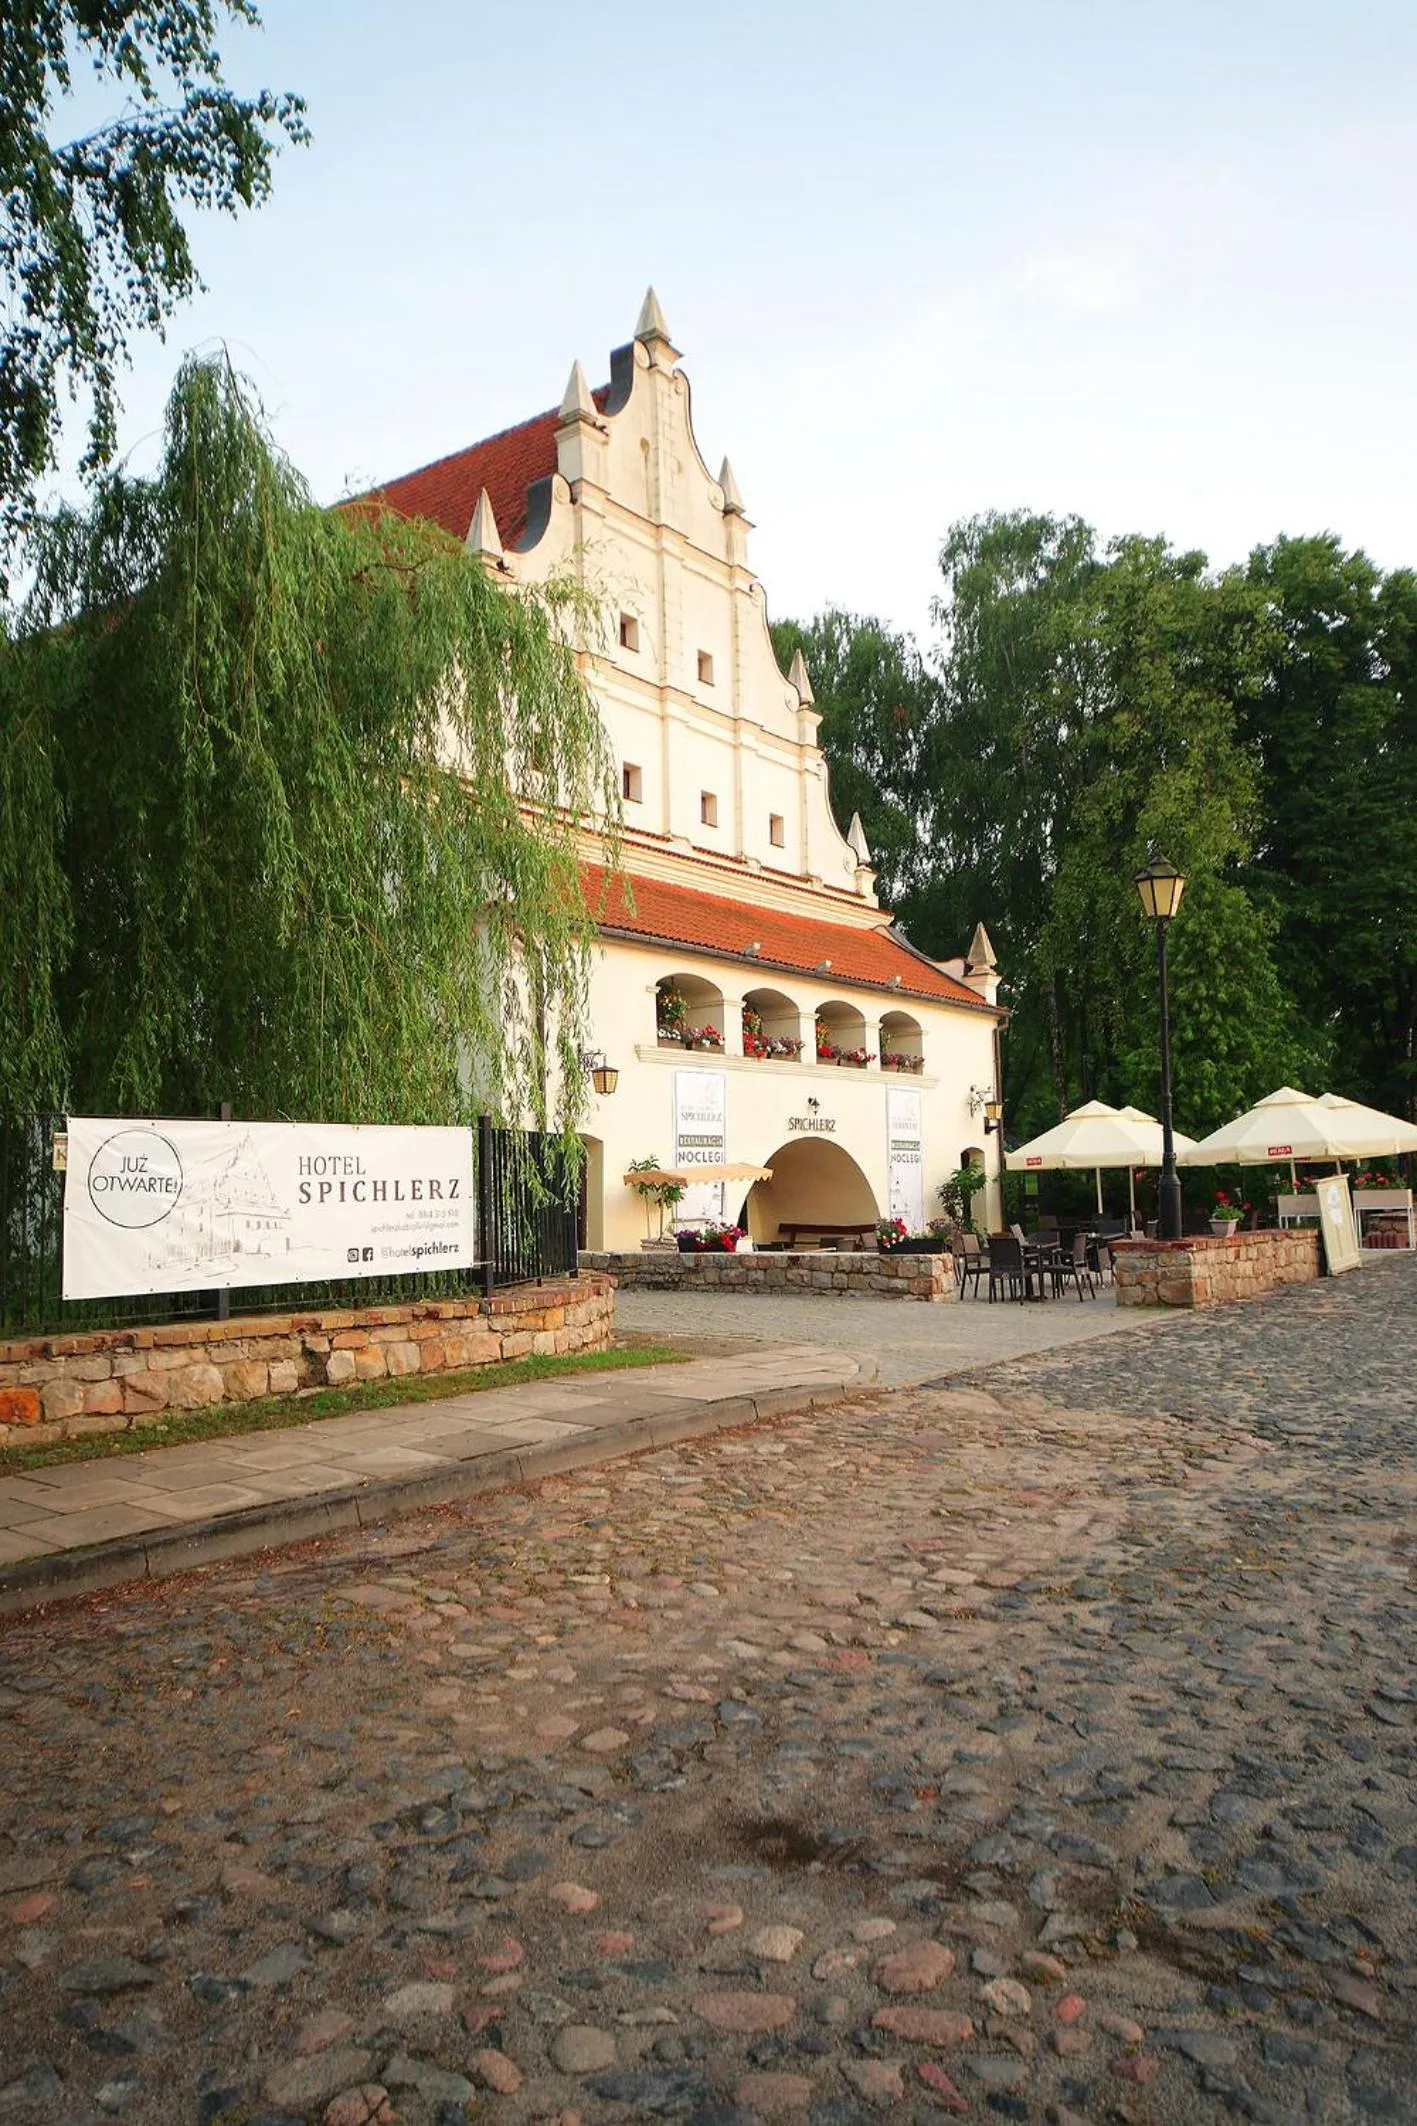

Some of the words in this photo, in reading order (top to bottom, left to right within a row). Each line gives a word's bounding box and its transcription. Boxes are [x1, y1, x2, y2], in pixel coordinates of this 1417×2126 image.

[788, 1117, 836, 1132] SPICHLERZ
[119, 1154, 149, 1173] JUŻ
[298, 1156, 367, 1176] HOTEL
[678, 1151, 724, 1163] NOCLEGI
[92, 1175, 178, 1193] OTWARTE!
[298, 1178, 460, 1203] SPICHLERZ
